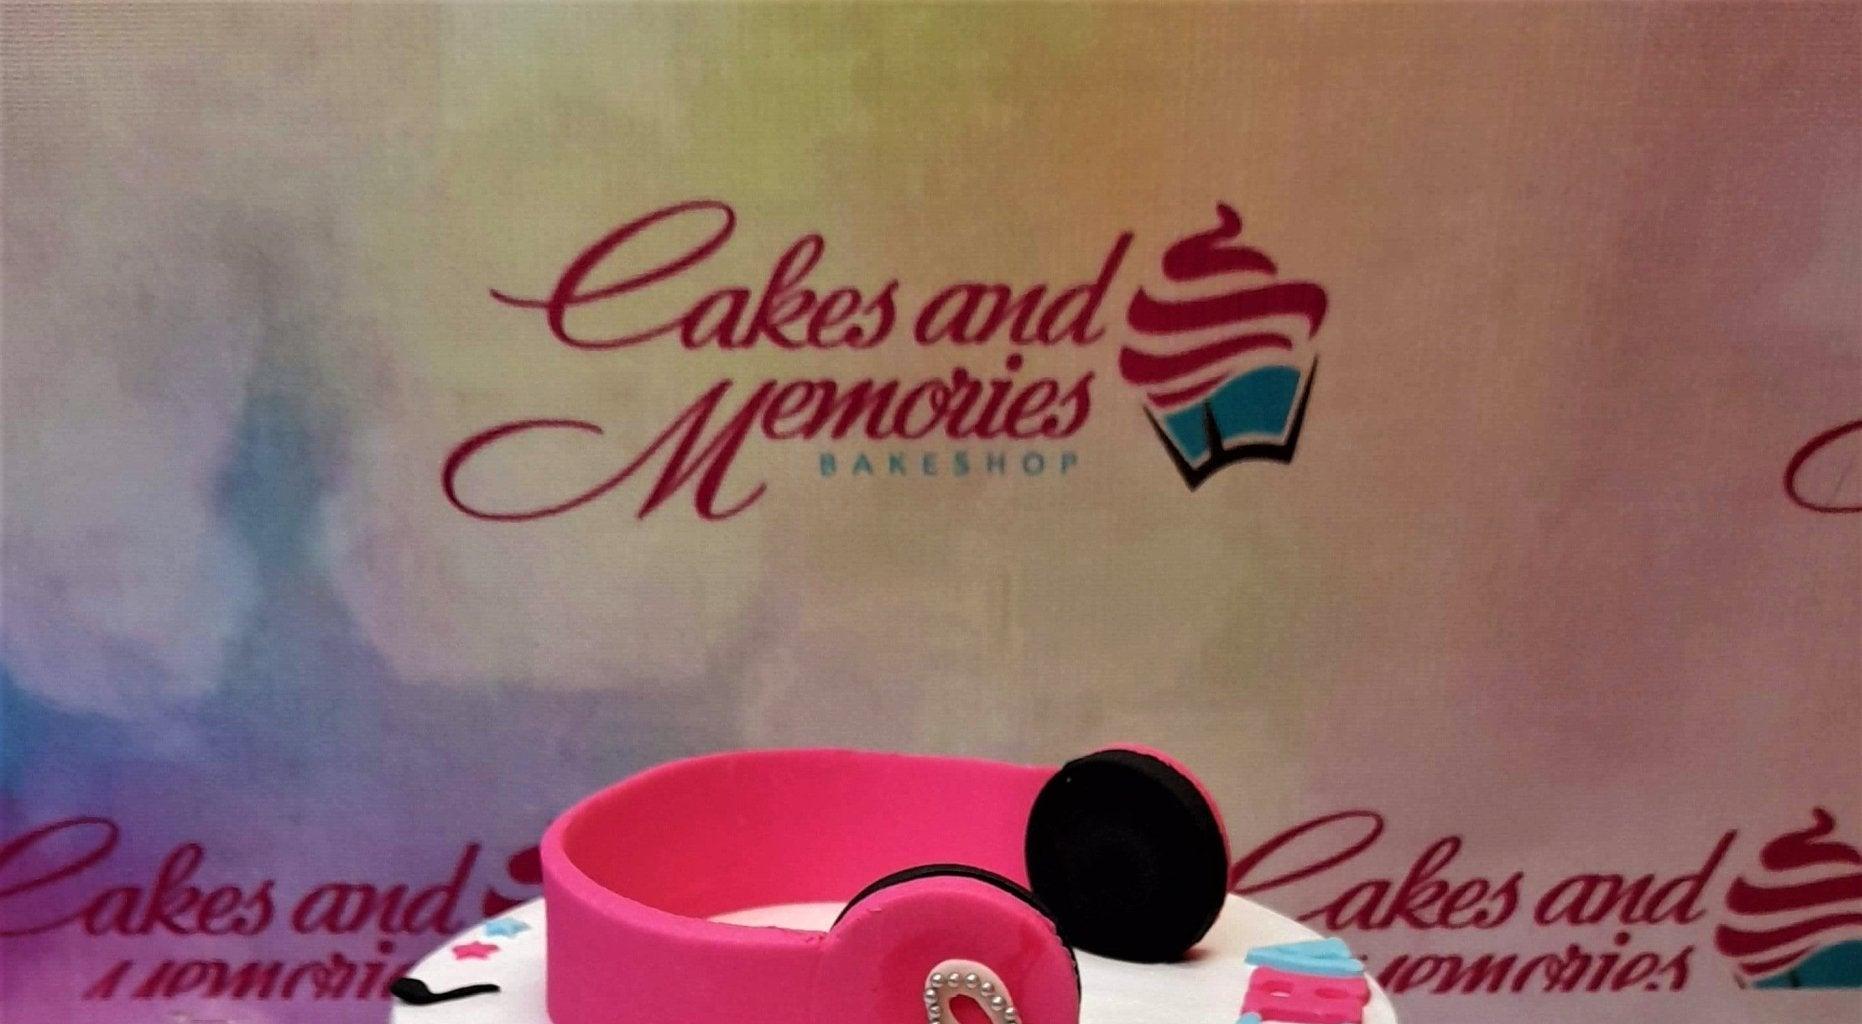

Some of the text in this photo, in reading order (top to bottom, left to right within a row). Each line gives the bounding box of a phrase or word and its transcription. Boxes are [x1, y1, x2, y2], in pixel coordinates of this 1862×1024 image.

[490, 200, 1136, 351] Cakes and
[441, 354, 1095, 522] Memories
[818, 452, 1079, 477] BAKESHOP
[291, 842, 482, 936] and
[1532, 829, 1740, 926] and
